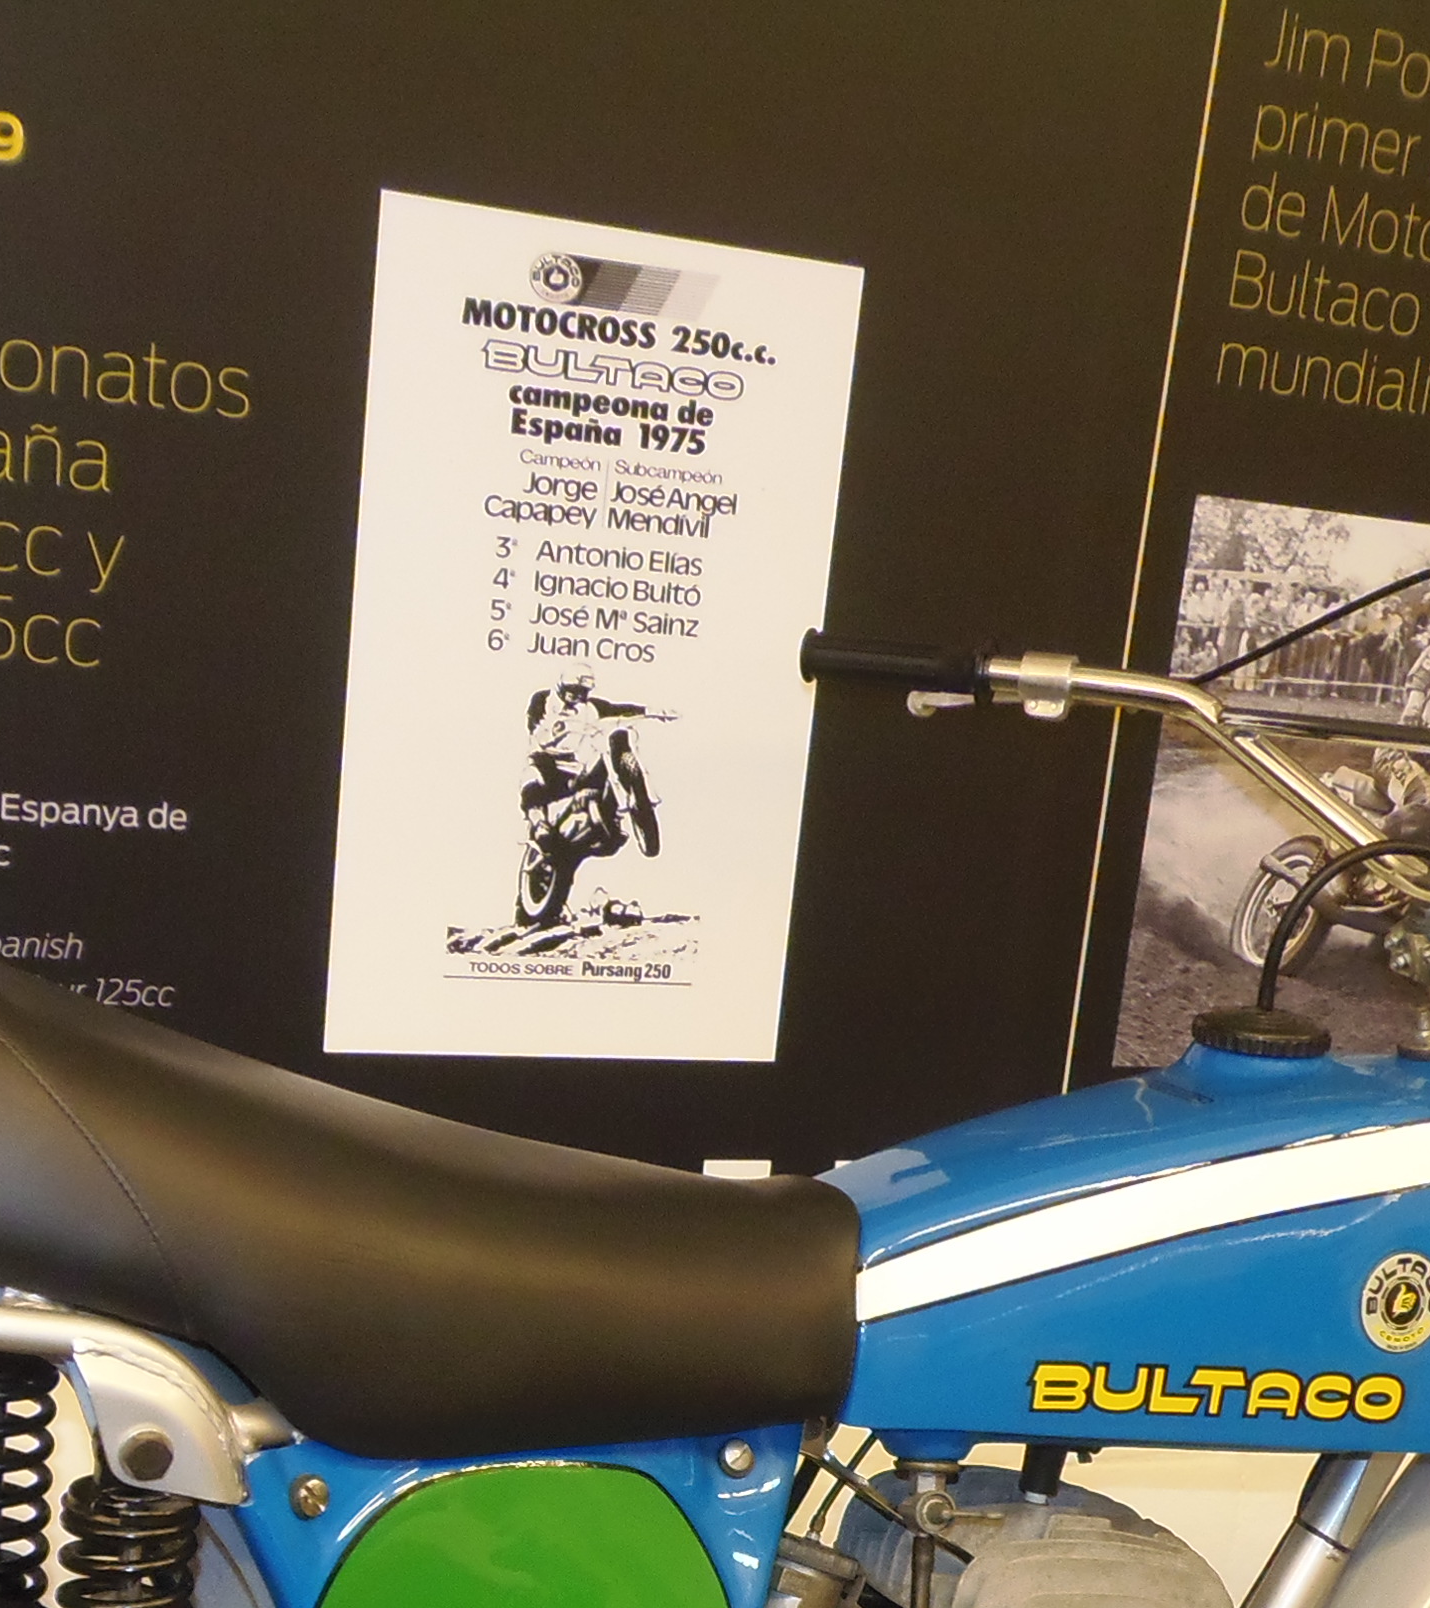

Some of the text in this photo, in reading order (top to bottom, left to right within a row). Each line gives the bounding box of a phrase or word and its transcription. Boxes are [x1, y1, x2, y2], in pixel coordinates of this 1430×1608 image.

[1264, 8, 1350, 83] Jim
[1252, 102, 1421, 177] primer
[1241, 174, 1306, 237] de
[1229, 250, 1421, 338] Bultaco
[462, 297, 777, 366] MOTOCROSS 250c.c.
[482, 339, 744, 400] BULTACO
[509, 383, 714, 427] campeona de
[510, 409, 705, 454] España 1975
[520, 450, 601, 472] Campeón
[614, 460, 723, 486] Subcampeón
[523, 473, 597, 501] Jorge
[610, 481, 737, 517] José Angel
[484, 496, 596, 529] Capapey
[608, 507, 710, 539] Mendívil
[88, 531, 124, 593] y
[536, 541, 643, 571] Antonio
[649, 550, 702, 576] Elías
[533, 570, 627, 601] Ignacio
[633, 580, 701, 607] Bultó
[529, 603, 589, 630] José
[633, 611, 699, 638] Sainz
[527, 631, 589, 658] Juan
[596, 639, 655, 663] Cros
[147, 800, 188, 831] de
[469, 961, 671, 981] TODOS SOBRE Pursang 250
[95, 978, 175, 1008] 125cc
[1028, 1361, 1405, 1423] BULTACO
